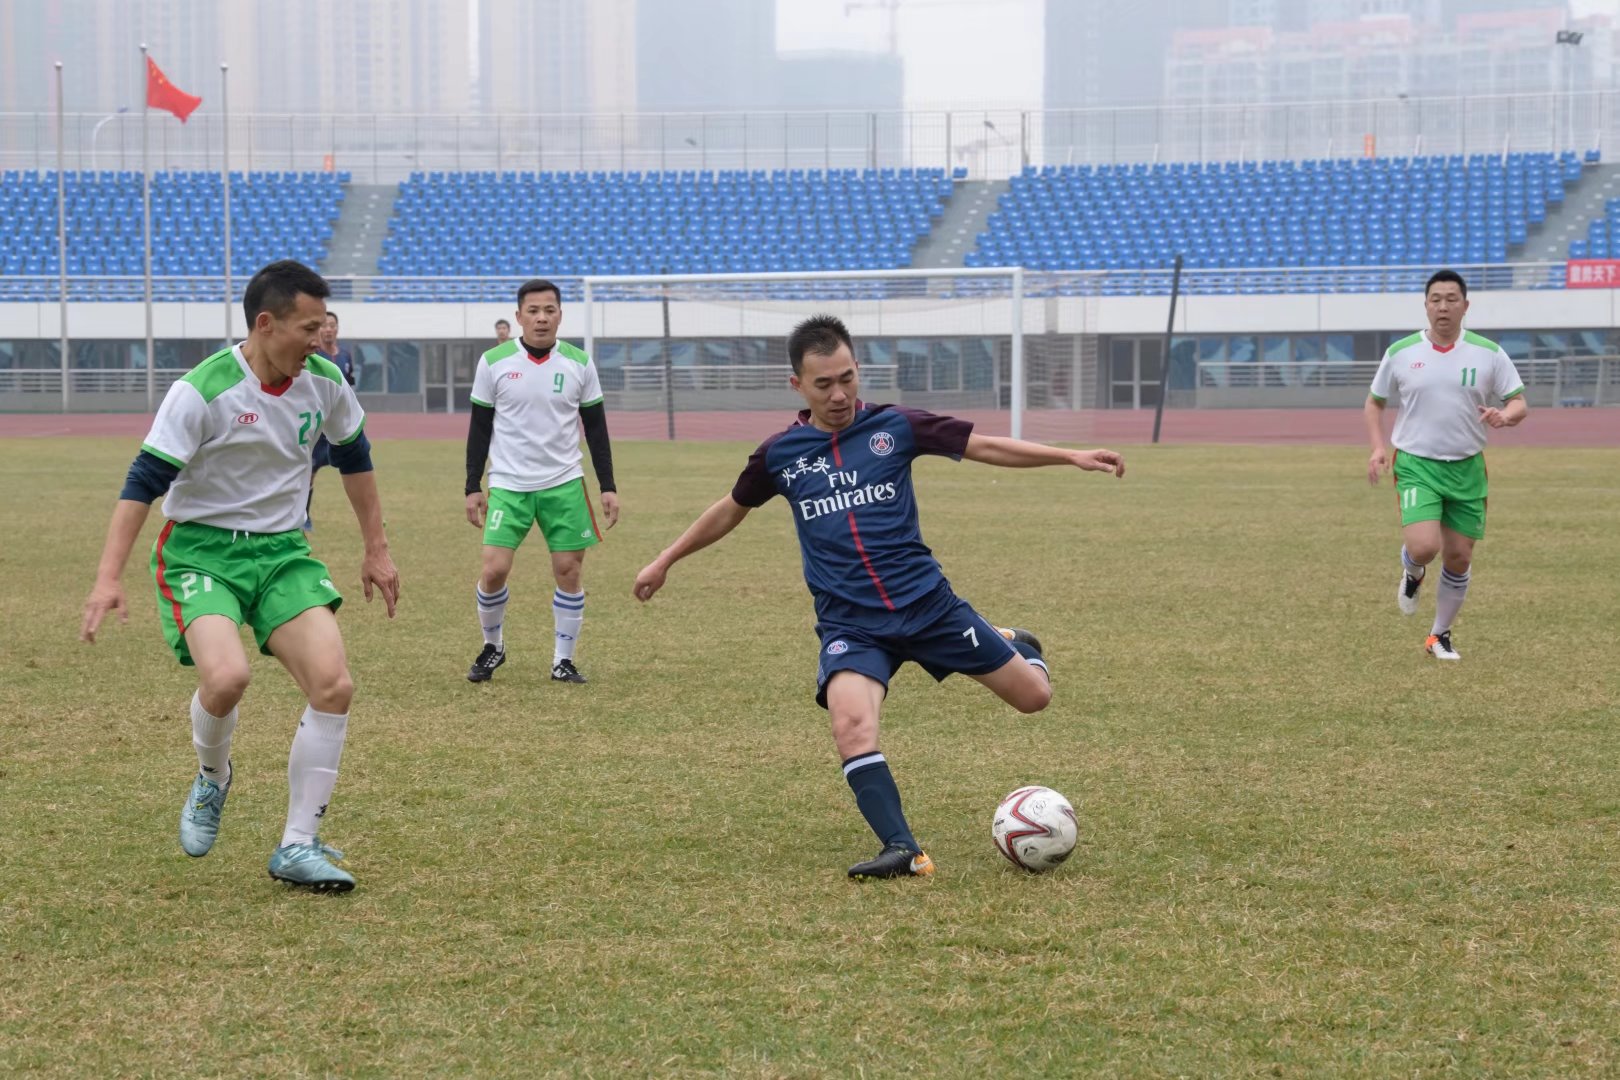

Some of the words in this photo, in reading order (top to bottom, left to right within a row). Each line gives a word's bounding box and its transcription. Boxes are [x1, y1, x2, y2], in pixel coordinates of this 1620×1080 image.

[1570, 264, 1616, 283] 天下
[552, 372, 565, 394] 9
[1461, 367, 1477, 387] 11
[298, 409, 323, 445] 21
[782, 456, 830, 487] 火车头
[828, 470, 858, 488] Fly
[799, 482, 896, 521] Emirates
[1403, 487, 1417, 509] 11
[489, 509, 504, 530] 9
[180, 572, 212, 600] 21
[962, 626, 980, 648] 7
